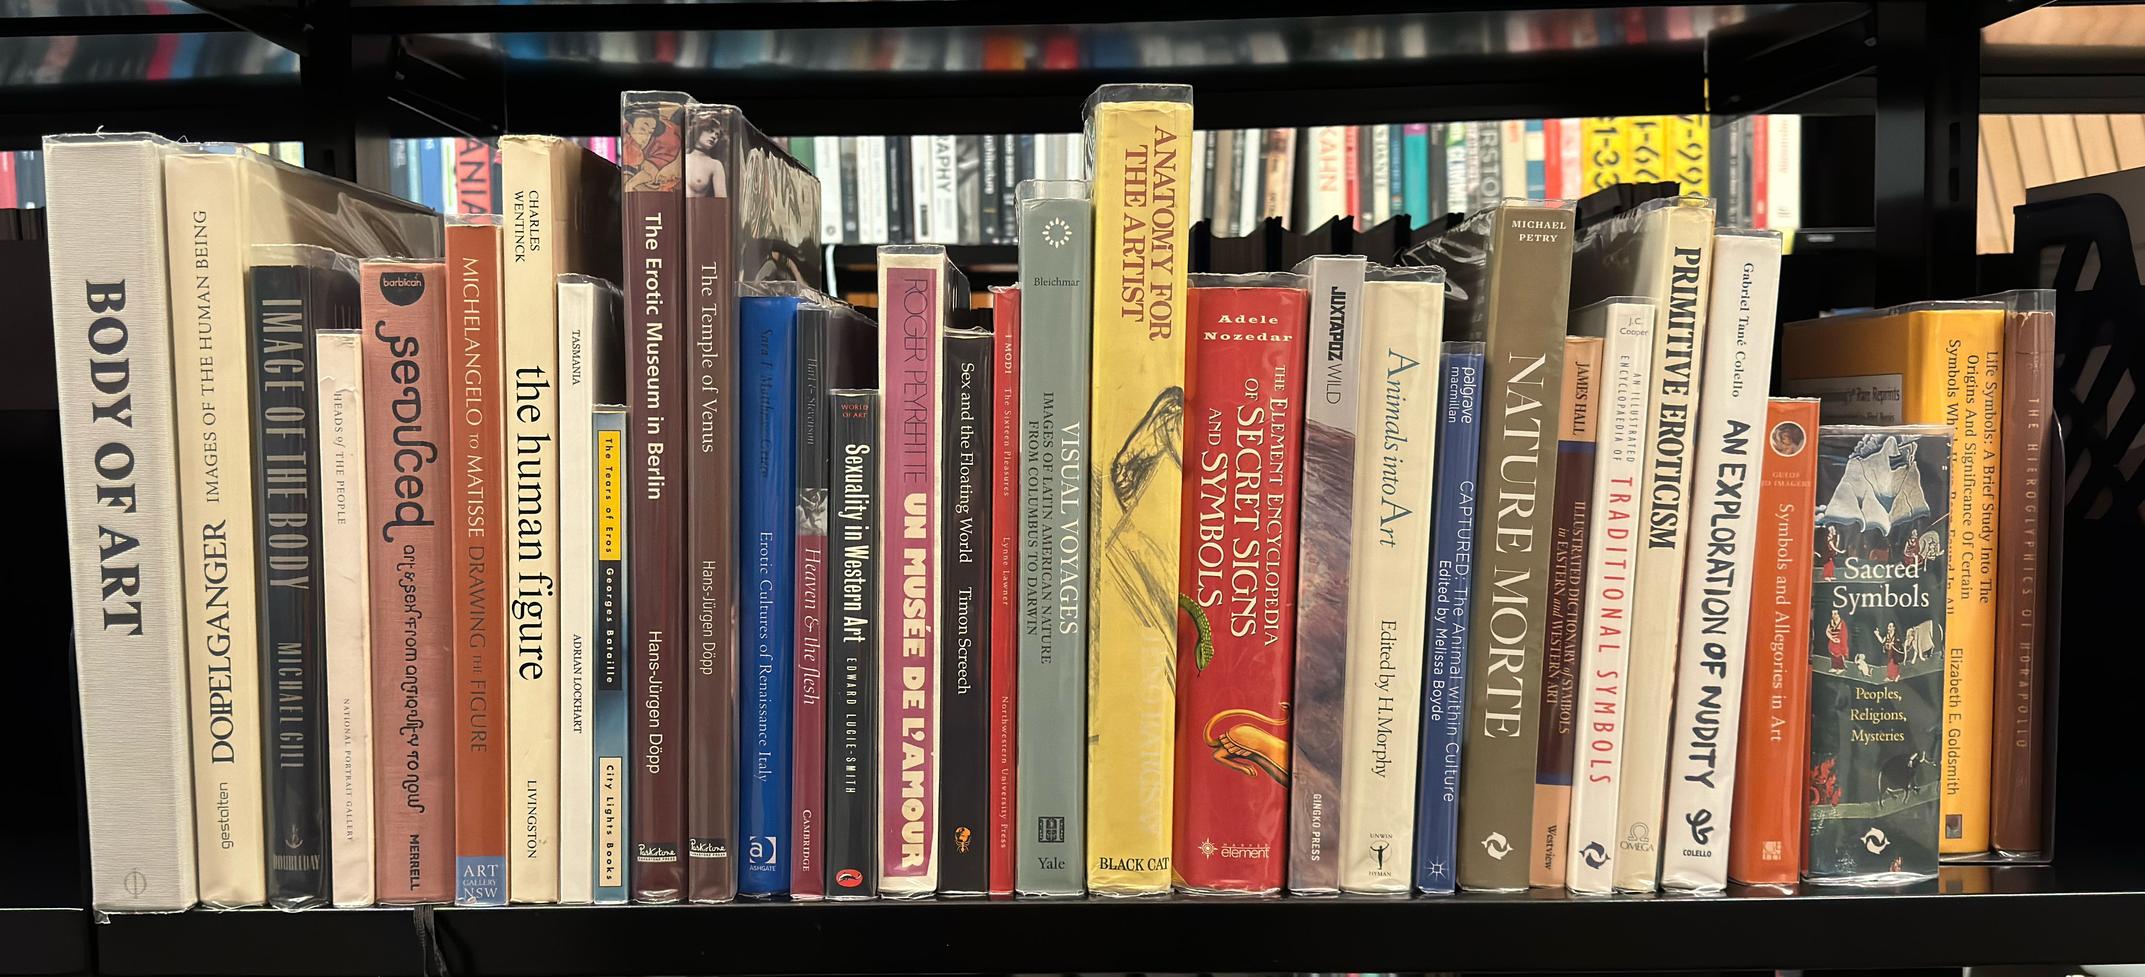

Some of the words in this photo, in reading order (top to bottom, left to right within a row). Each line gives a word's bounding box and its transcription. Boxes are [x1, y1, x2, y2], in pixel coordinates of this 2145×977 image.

[1123, 144, 1148, 208] THE
[1151, 125, 1177, 275] ANATOMY
[514, 190, 525, 263] WENTINCK
[528, 190, 540, 252] CHARLES
[645, 212, 663, 251] The
[1511, 220, 1567, 230] MICHAEL
[1519, 234, 1558, 243] PETRY
[383, 276, 422, 288] barbican
[645, 257, 664, 315] Erotic
[701, 261, 717, 297] The
[1033, 277, 1080, 287] Bleichmar
[1121, 213, 1147, 323] ARTIST
[1740, 262, 1755, 314] Gabriel
[696, 303, 718, 369] Temple
[903, 279, 928, 362] ROGER
[1149, 282, 1173, 342] FOR
[1218, 314, 1279, 324] Adele
[1619, 327, 1649, 337] Cooper
[1662, 246, 1702, 397] PRIMITIVE
[85, 278, 133, 429] BODY
[262, 299, 305, 393] IMAGE
[463, 257, 483, 426] MICHELANGELO
[572, 329, 581, 386] TASMANIA
[1203, 331, 1293, 342] Nozedar
[646, 322, 664, 410] Museum
[702, 375, 719, 394] of
[961, 363, 975, 389] Sex
[1245, 378, 1259, 401] OF
[1274, 364, 1286, 391] THE
[1326, 362, 1343, 405] WILD
[1575, 361, 1590, 401] JAMES
[1732, 350, 1747, 398] Colello
[333, 392, 343, 434] HEADS
[516, 365, 551, 424] the
[960, 392, 975, 421] and
[1383, 347, 1420, 452] Animals
[1448, 366, 1460, 423] macmillan
[1461, 367, 1476, 424] palgrave
[1614, 355, 1630, 443] ENCYCLOPAEDIA
[265, 406, 306, 440] OF
[337, 436, 346, 449] of
[469, 433, 479, 449] TO
[648, 416, 665, 435] in
[702, 397, 718, 453] Venus
[960, 424, 974, 449] the
[1208, 407, 1222, 446] AND
[1269, 397, 1288, 486] ELEMENT
[1573, 403, 1587, 436] HALL
[1720, 419, 1752, 456] AN
[335, 452, 345, 477] THE
[605, 438, 613, 459] The
[648, 443, 666, 500] Berlin
[1060, 421, 1080, 515] VISUAL
[1234, 405, 1265, 532] SECRET
[1496, 352, 1547, 555] NATURE
[1613, 449, 1623, 462] OF
[94, 442, 137, 514] OF
[266, 450, 308, 499] THE
[467, 455, 485, 538] MATISSE
[516, 432, 552, 562] human
[605, 467, 613, 500] Tears
[838, 444, 871, 520] Sexuality
[955, 453, 974, 515] Floating
[1003, 451, 1011, 497] Pleasures
[1380, 455, 1404, 496] into
[1648, 402, 1689, 551] EROTICISM
[336, 479, 346, 526] PEOPLE
[605, 507, 614, 520] of
[904, 493, 927, 539] UN
[1379, 496, 1413, 548] Art
[268, 512, 310, 590] BODY
[605, 527, 614, 553] Eros
[759, 531, 773, 575] Erotic
[844, 525, 870, 541] in
[959, 518, 973, 564] World
[1197, 452, 1229, 608] SYMBOLS
[1454, 480, 1475, 580] CAPTURED:
[1700, 463, 1747, 635] EXPLORATION
[1775, 503, 1794, 570] Symbols
[98, 524, 144, 636] ART
[804, 548, 821, 610] Heaven
[843, 545, 870, 611] Western
[1059, 519, 1079, 635] VOYAGES
[1230, 538, 1261, 638] SIGNS
[1263, 492, 1284, 647] ENCYCLOPEDIA
[1598, 477, 1633, 653] TRADITIONAL
[1843, 555, 1920, 579] Sacred
[468, 546, 486, 649] DRAWING
[759, 579, 773, 640] Cultures
[902, 548, 931, 657] MUSÉE
[958, 587, 973, 635] Timon
[1452, 586, 1468, 617] The
[1775, 576, 1791, 605] and
[1832, 584, 1930, 615] Symbols
[511, 571, 554, 680] figure
[804, 616, 819, 632] &
[843, 616, 869, 643] Art
[759, 643, 773, 660] of
[803, 637, 821, 662] the
[957, 638, 972, 695] Screech
[1449, 622, 1467, 679] Animal
[1484, 565, 1531, 739] MORTE
[1700, 642, 1727, 680] OF
[1770, 613, 1790, 689] Allegories
[646, 629, 663, 728] Hans-Jürgen
[798, 664, 821, 705] flesh
[901, 667, 926, 710] DE
[1855, 687, 1903, 704] Peoples,
[1949, 648, 1963, 708] Elizabeth
[343, 698, 351, 749] NATIONAL
[470, 679, 487, 753] FIGURE
[758, 664, 773, 747] Renaissance
[1446, 684, 1462, 736] within
[1589, 669, 1619, 784] SYMBOLS
[1771, 695, 1786, 710] in
[1850, 708, 1907, 725] Religions,
[1948, 713, 1962, 724] E.
[1001, 696, 1009, 764] Northwestern
[1683, 685, 1723, 790] NUDITY
[1770, 715, 1787, 742] Art
[1850, 729, 1905, 746] Mysteries
[344, 750, 353, 797] PORTRAIT
[646, 734, 664, 774] Döpp
[753, 751, 772, 783] Italy
[1443, 742, 1460, 802] Culture
[1947, 728, 1961, 796] Goldsmith
[216, 781, 234, 850] gestalten
[901, 717, 926, 869] L'AMOUR
[1000, 768, 1009, 819] University
[1312, 793, 1322, 829] GINGKO
[345, 800, 354, 841] GALLERY
[526, 780, 537, 859] LIVINGSTON
[802, 809, 812, 872] CAMBRIDGE
[1001, 823, 1009, 849] Press
[273, 854, 320, 872] DOUBLEDAY
[409, 834, 421, 891] MERRELL
[1038, 856, 1065, 870] Yale
[1099, 857, 1144, 872] BLACK
[1147, 856, 1170, 870] CAT
[1220, 846, 1270, 859] element
[1311, 831, 1321, 861] PRESS
[1544, 824, 1557, 870] Westview
[1619, 840, 1654, 852] OMEGA
[1682, 849, 1712, 858] COLELLO
[463, 864, 499, 877] ART
[463, 887, 498, 899] NSW
